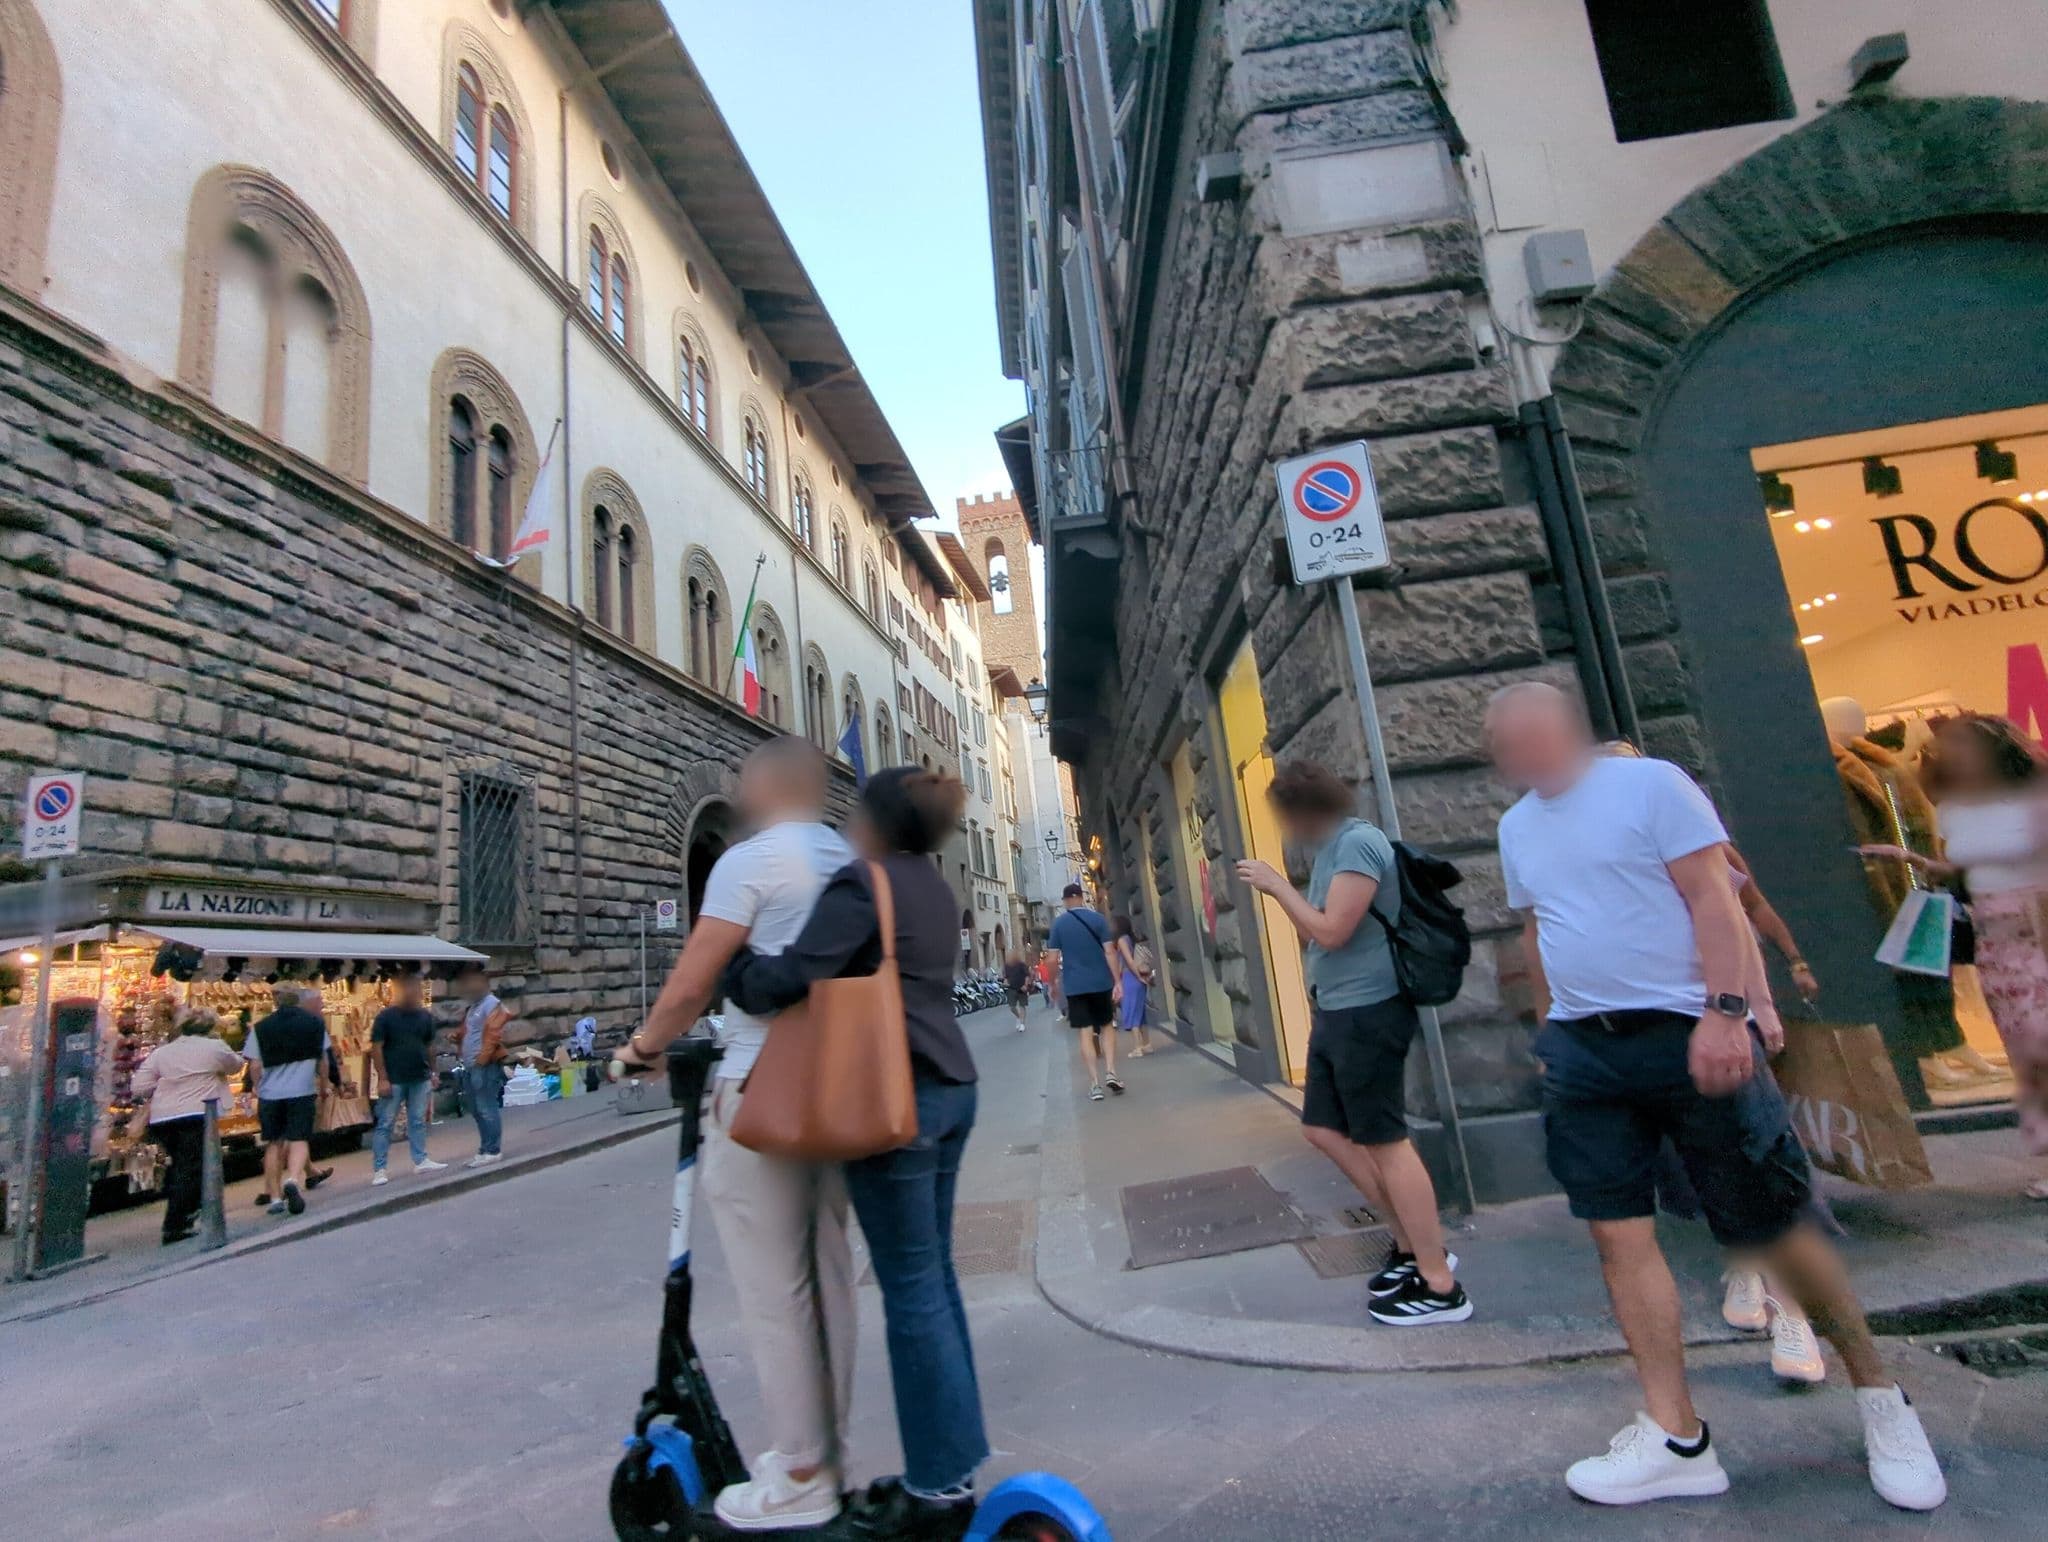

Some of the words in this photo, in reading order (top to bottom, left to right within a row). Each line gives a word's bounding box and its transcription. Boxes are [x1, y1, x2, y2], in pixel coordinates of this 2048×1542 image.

[1309, 523, 1362, 548] 0-24
[159, 891, 191, 912] LA
[201, 893, 293, 916] NAZIONE
